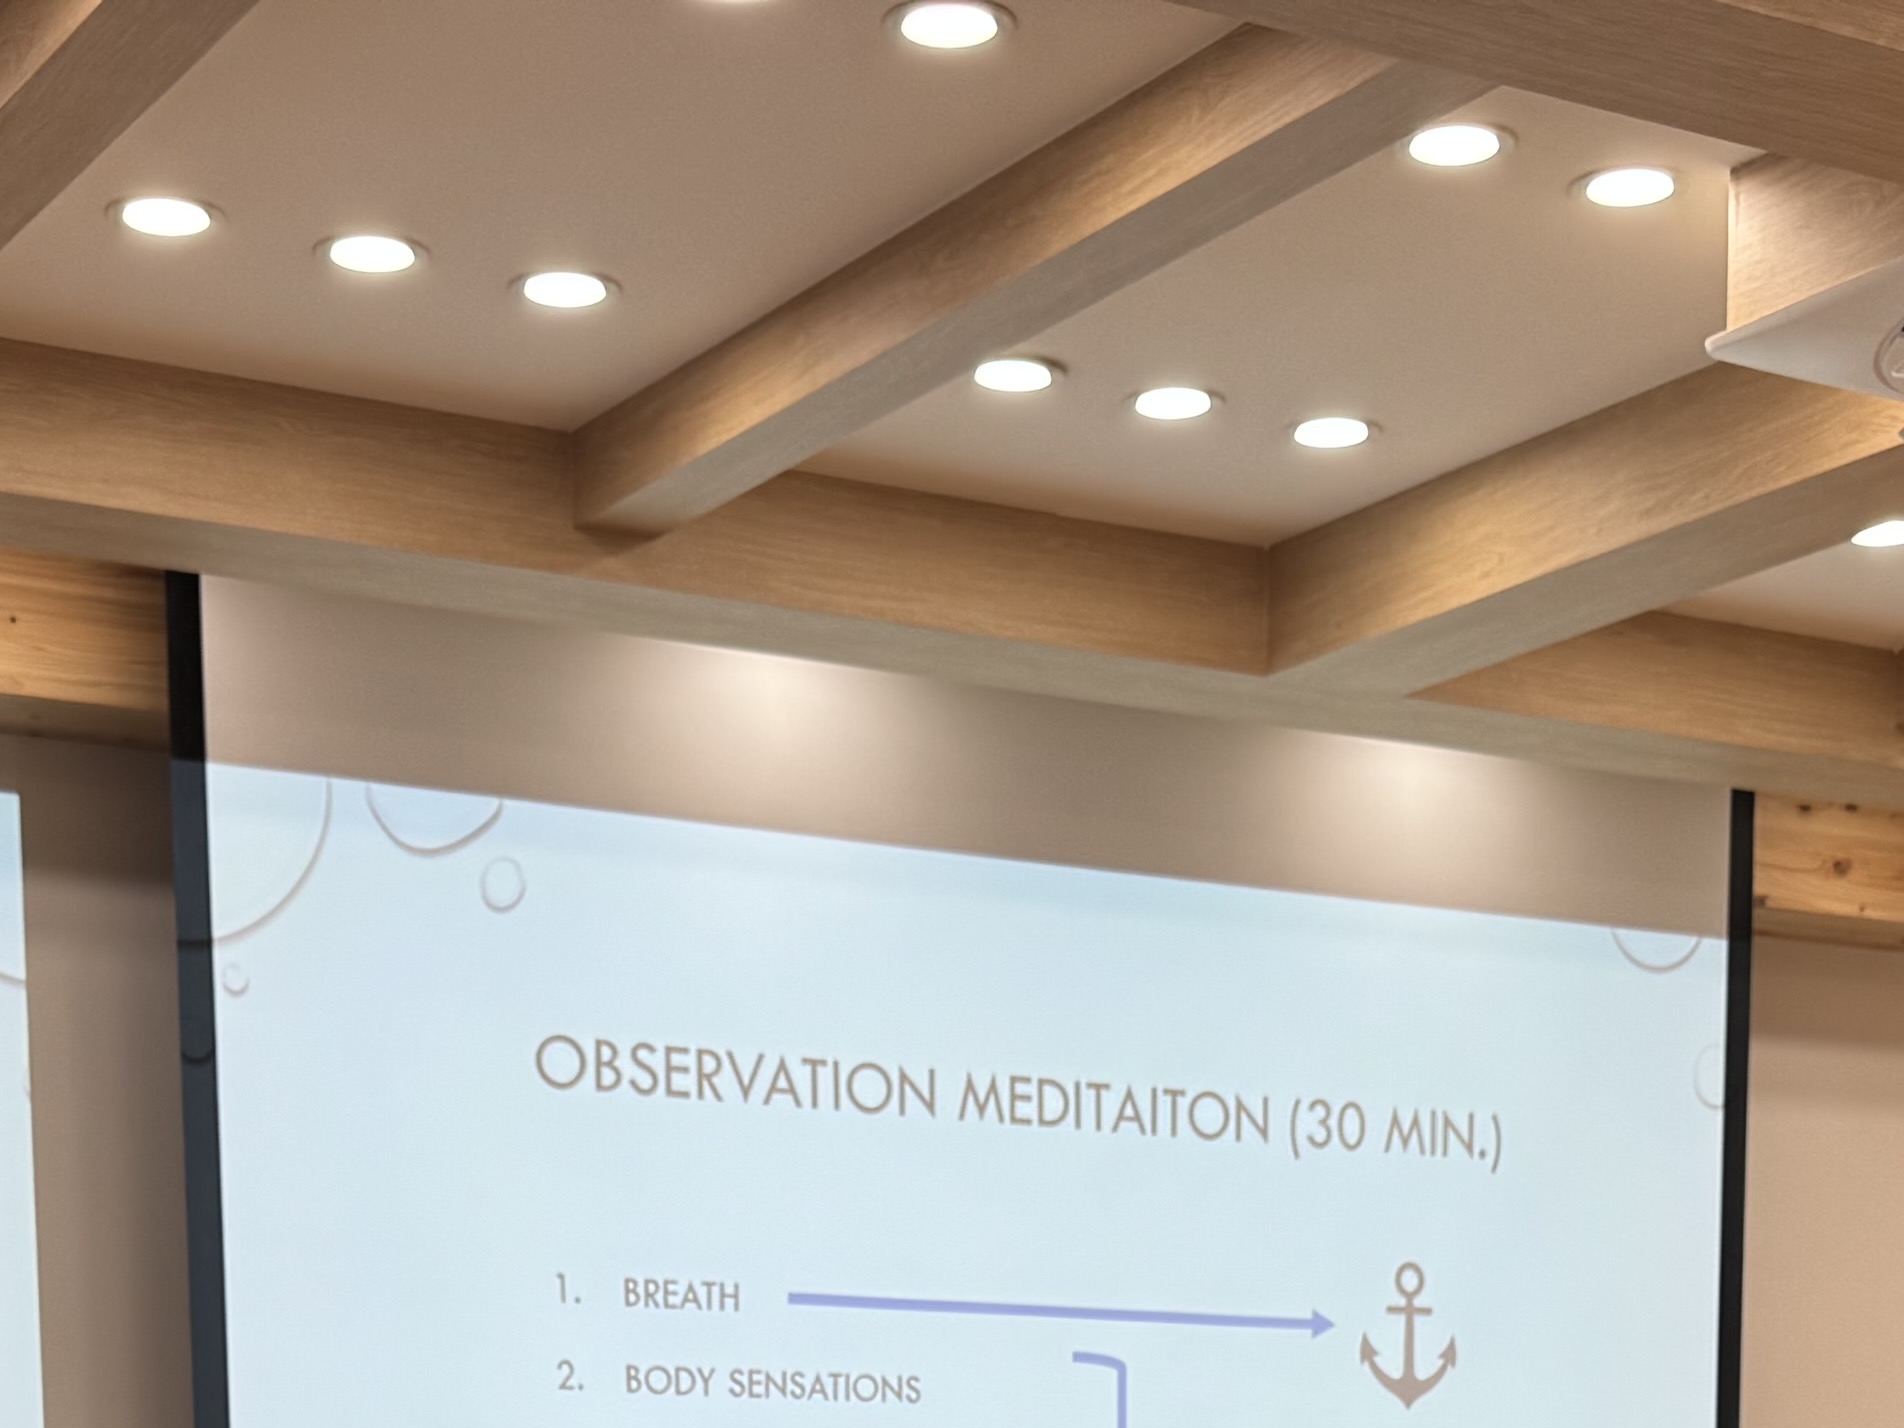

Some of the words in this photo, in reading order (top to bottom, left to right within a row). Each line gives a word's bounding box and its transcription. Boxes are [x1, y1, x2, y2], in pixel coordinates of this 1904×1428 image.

[535, 1034, 936, 1118] OBSERVATION
[958, 1072, 1269, 1144] MEDITAITON
[1290, 1098, 1366, 1160] (30
[1384, 1105, 1502, 1174] MIN.)
[556, 1272, 581, 1304] 1.
[624, 1277, 739, 1312] BREATH
[557, 1359, 584, 1391] 2.
[625, 1364, 716, 1397] BODY
[728, 1367, 921, 1404] SENSATIONS
